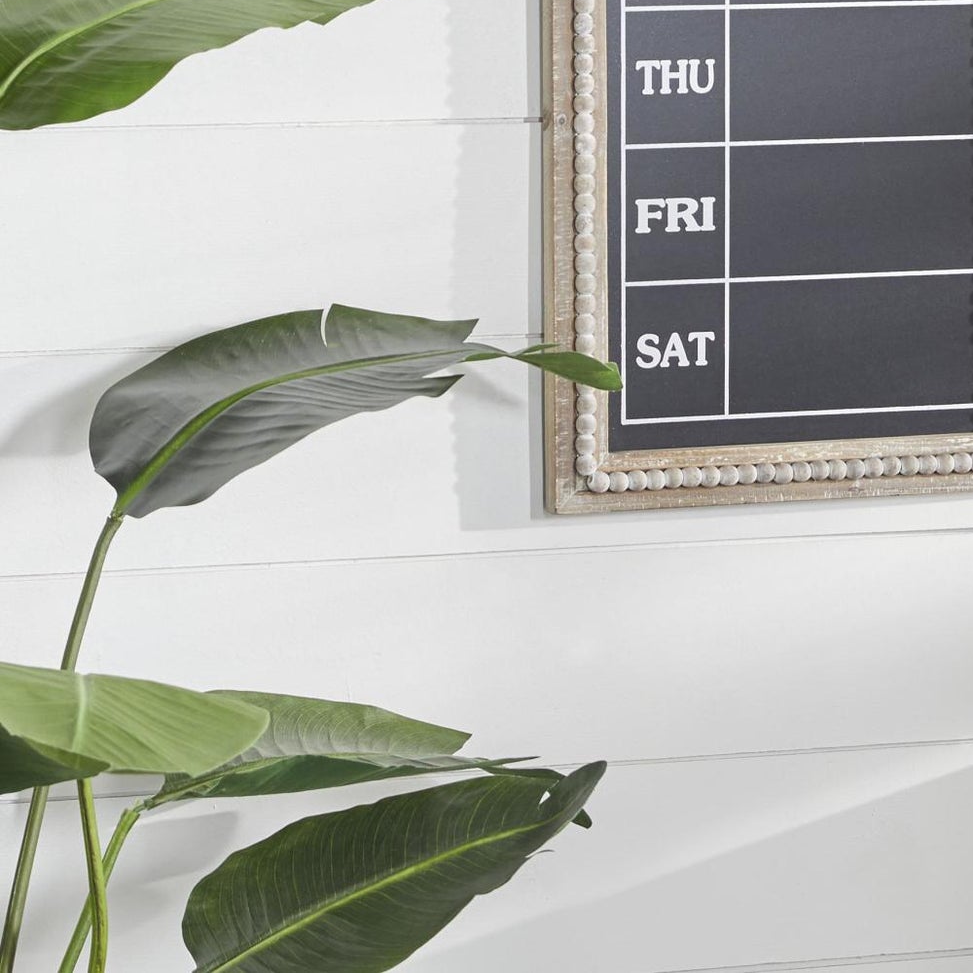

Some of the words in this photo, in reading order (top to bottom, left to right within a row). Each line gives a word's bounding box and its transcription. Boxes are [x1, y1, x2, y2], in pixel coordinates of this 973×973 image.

[635, 58, 716, 95] THU
[635, 196, 717, 233] FRI
[635, 331, 716, 369] SAT
